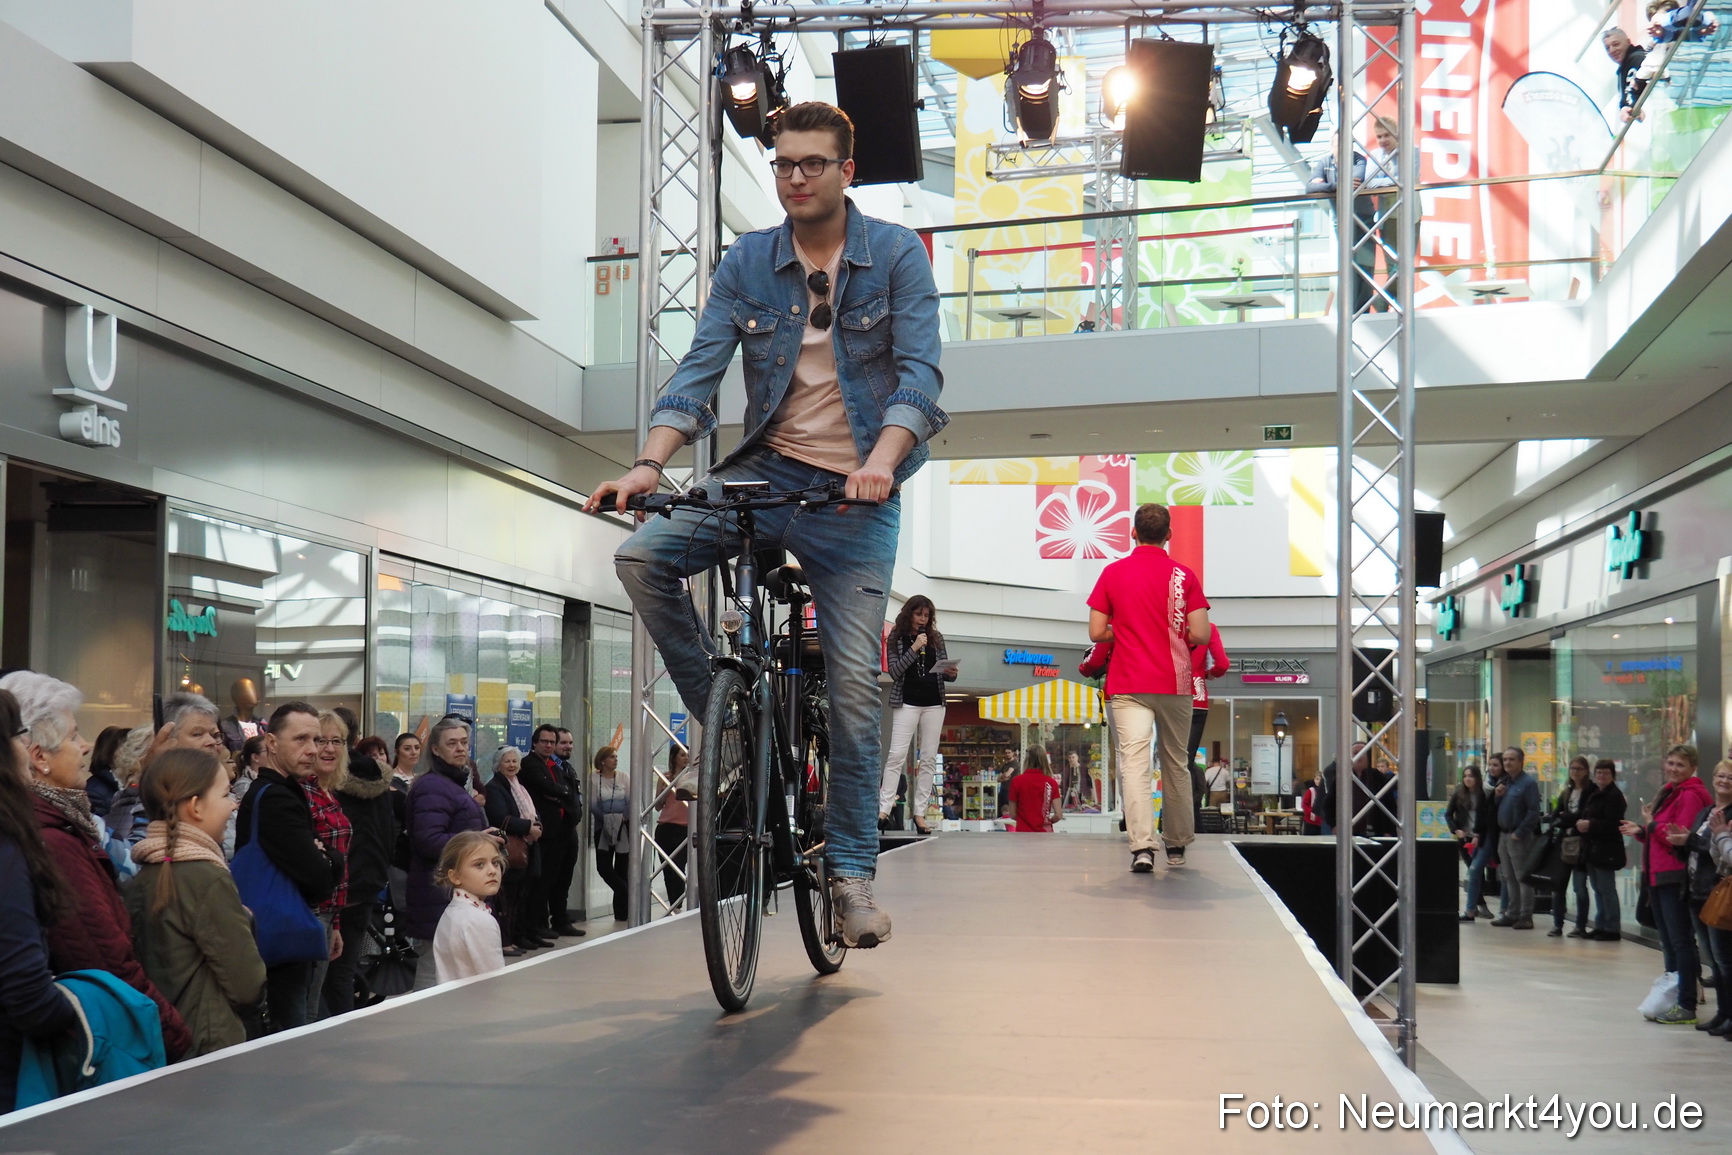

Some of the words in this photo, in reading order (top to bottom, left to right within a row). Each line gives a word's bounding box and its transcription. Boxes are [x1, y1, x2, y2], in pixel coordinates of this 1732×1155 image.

[68, 304, 117, 391] U
[1004, 649, 1054, 665] Spielwaren
[1034, 665, 1060, 677] Krömer
[1226, 658, 1309, 672] EBOXX
